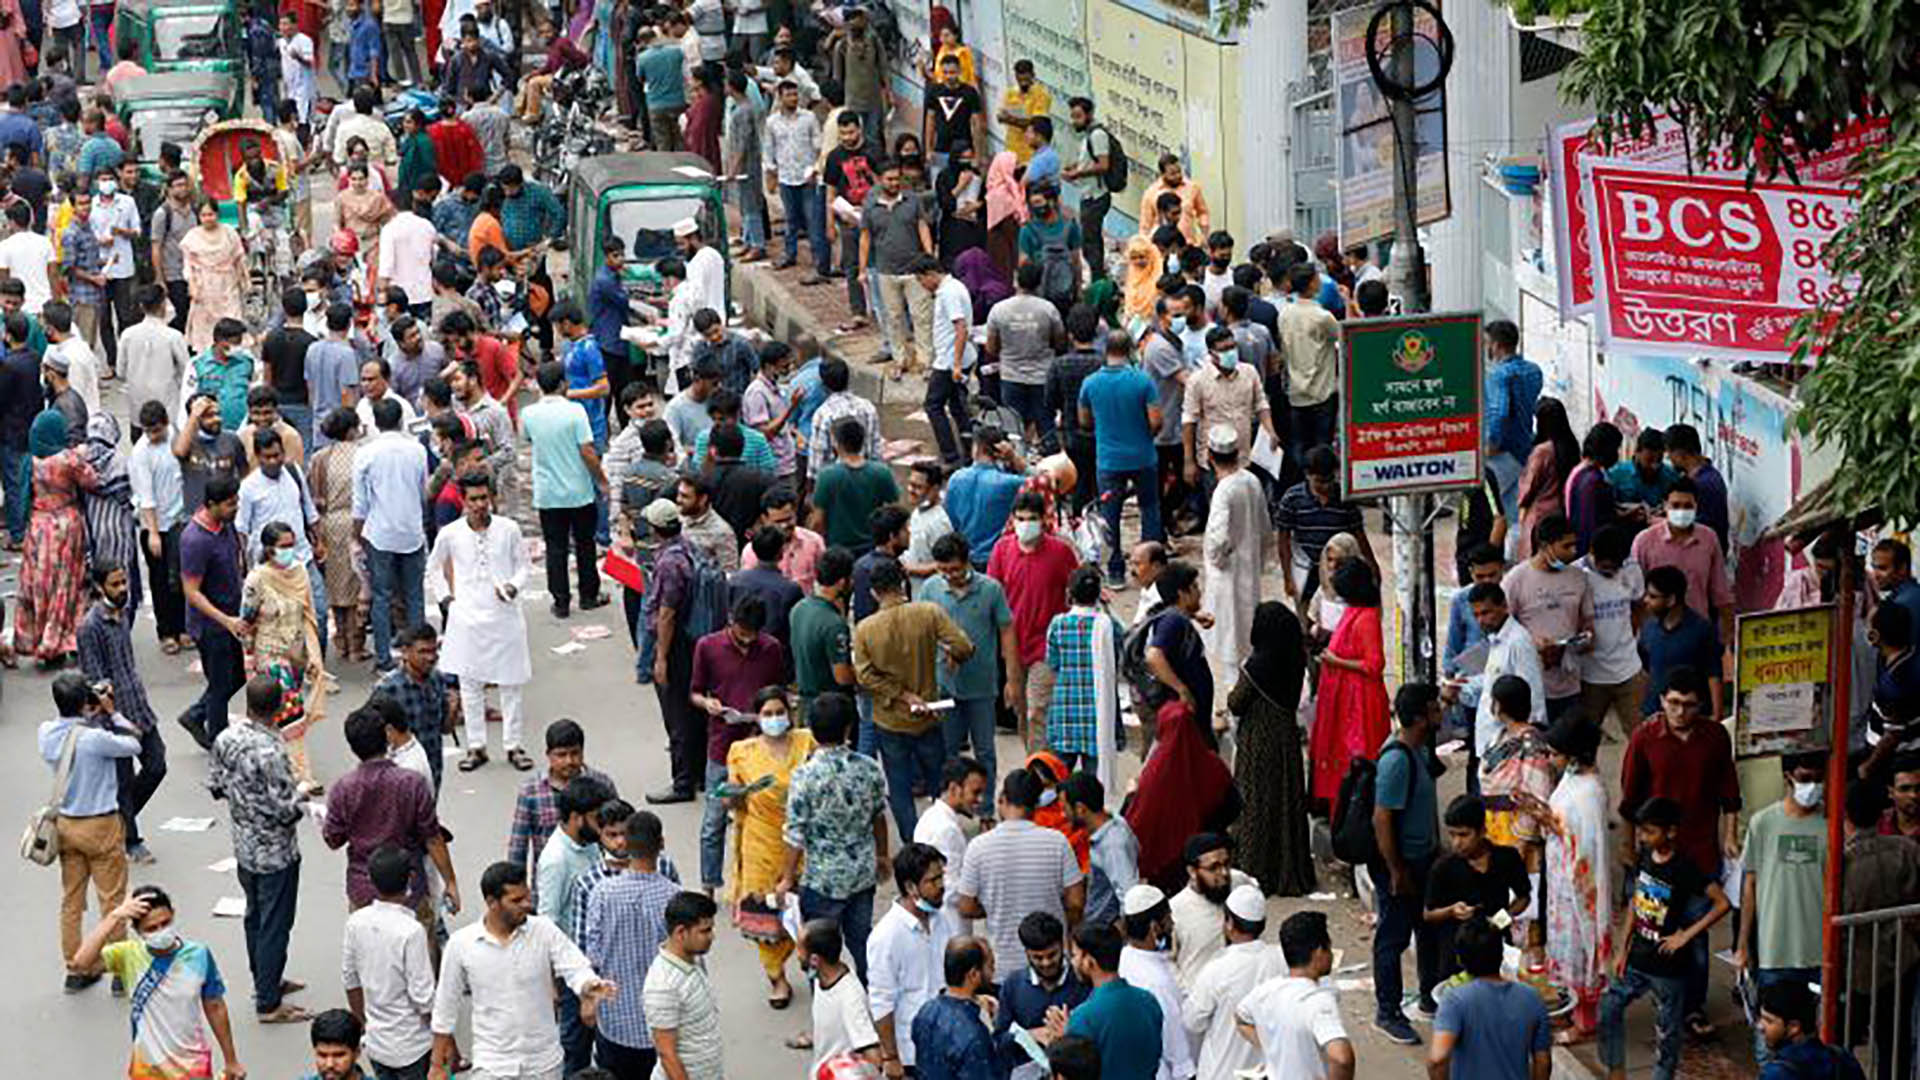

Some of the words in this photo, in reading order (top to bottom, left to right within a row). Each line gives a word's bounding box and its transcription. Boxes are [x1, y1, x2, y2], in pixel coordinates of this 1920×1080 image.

[1616, 190, 1763, 251] BCS
[1786, 198, 1837, 231] ৪৫
[1622, 297, 1738, 342] উত্তরণ
[1374, 459, 1456, 481] WALTON
